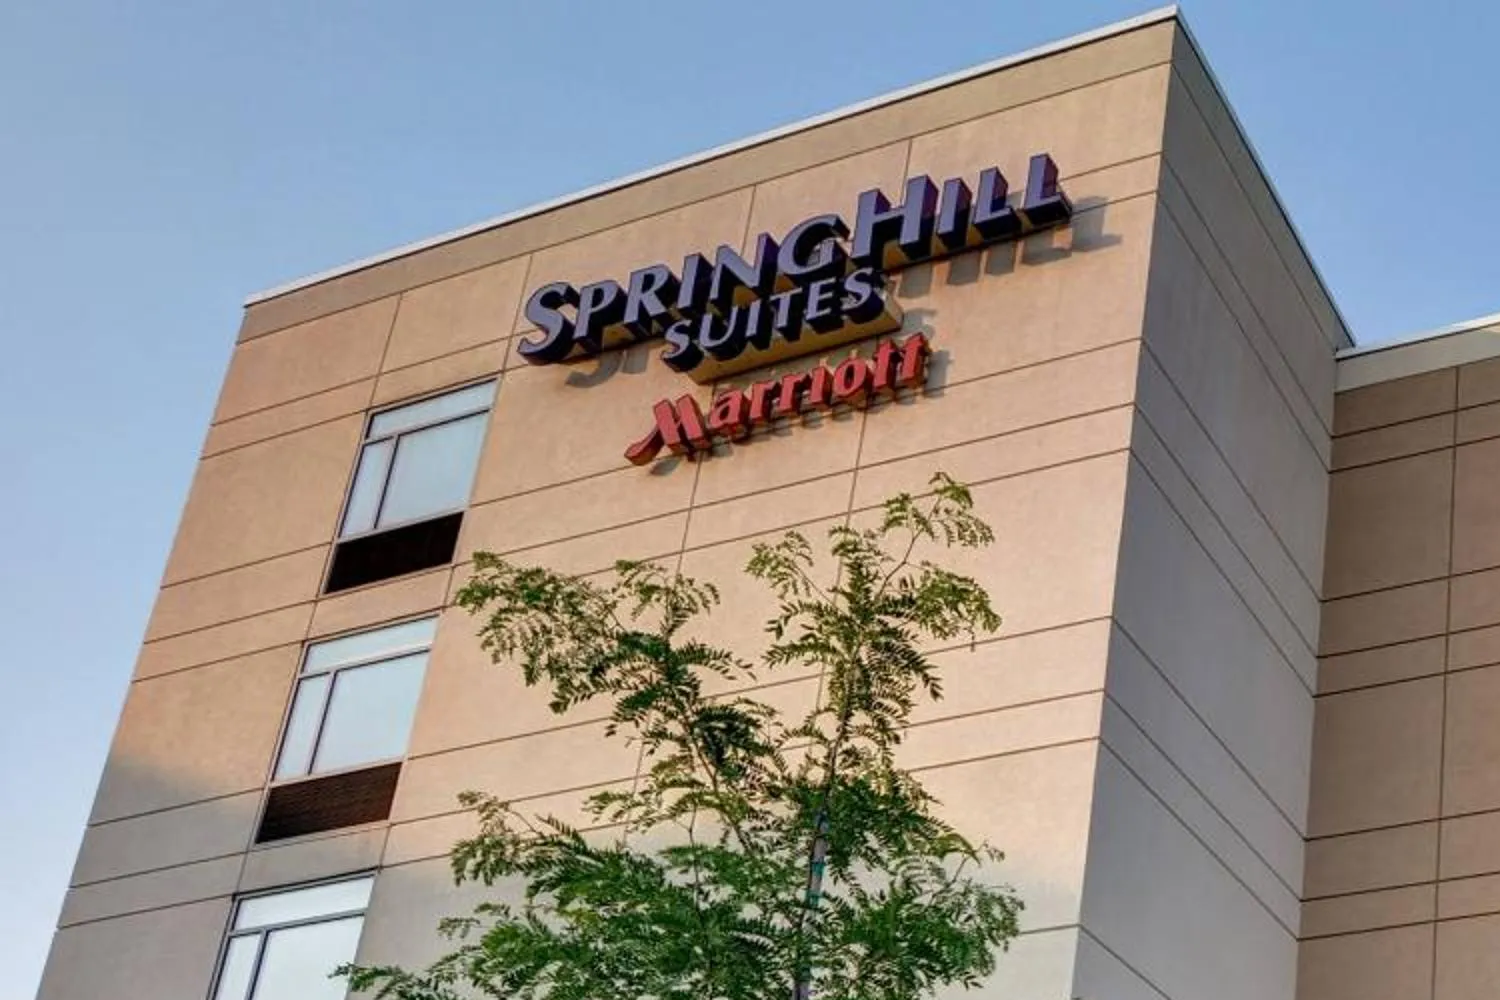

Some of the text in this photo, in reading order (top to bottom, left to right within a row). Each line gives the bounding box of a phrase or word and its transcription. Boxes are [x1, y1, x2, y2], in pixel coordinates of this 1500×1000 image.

[517, 153, 1072, 365] SPRINGHILL
[660, 266, 886, 372] SUITES
[624, 331, 930, 466] Marriott
